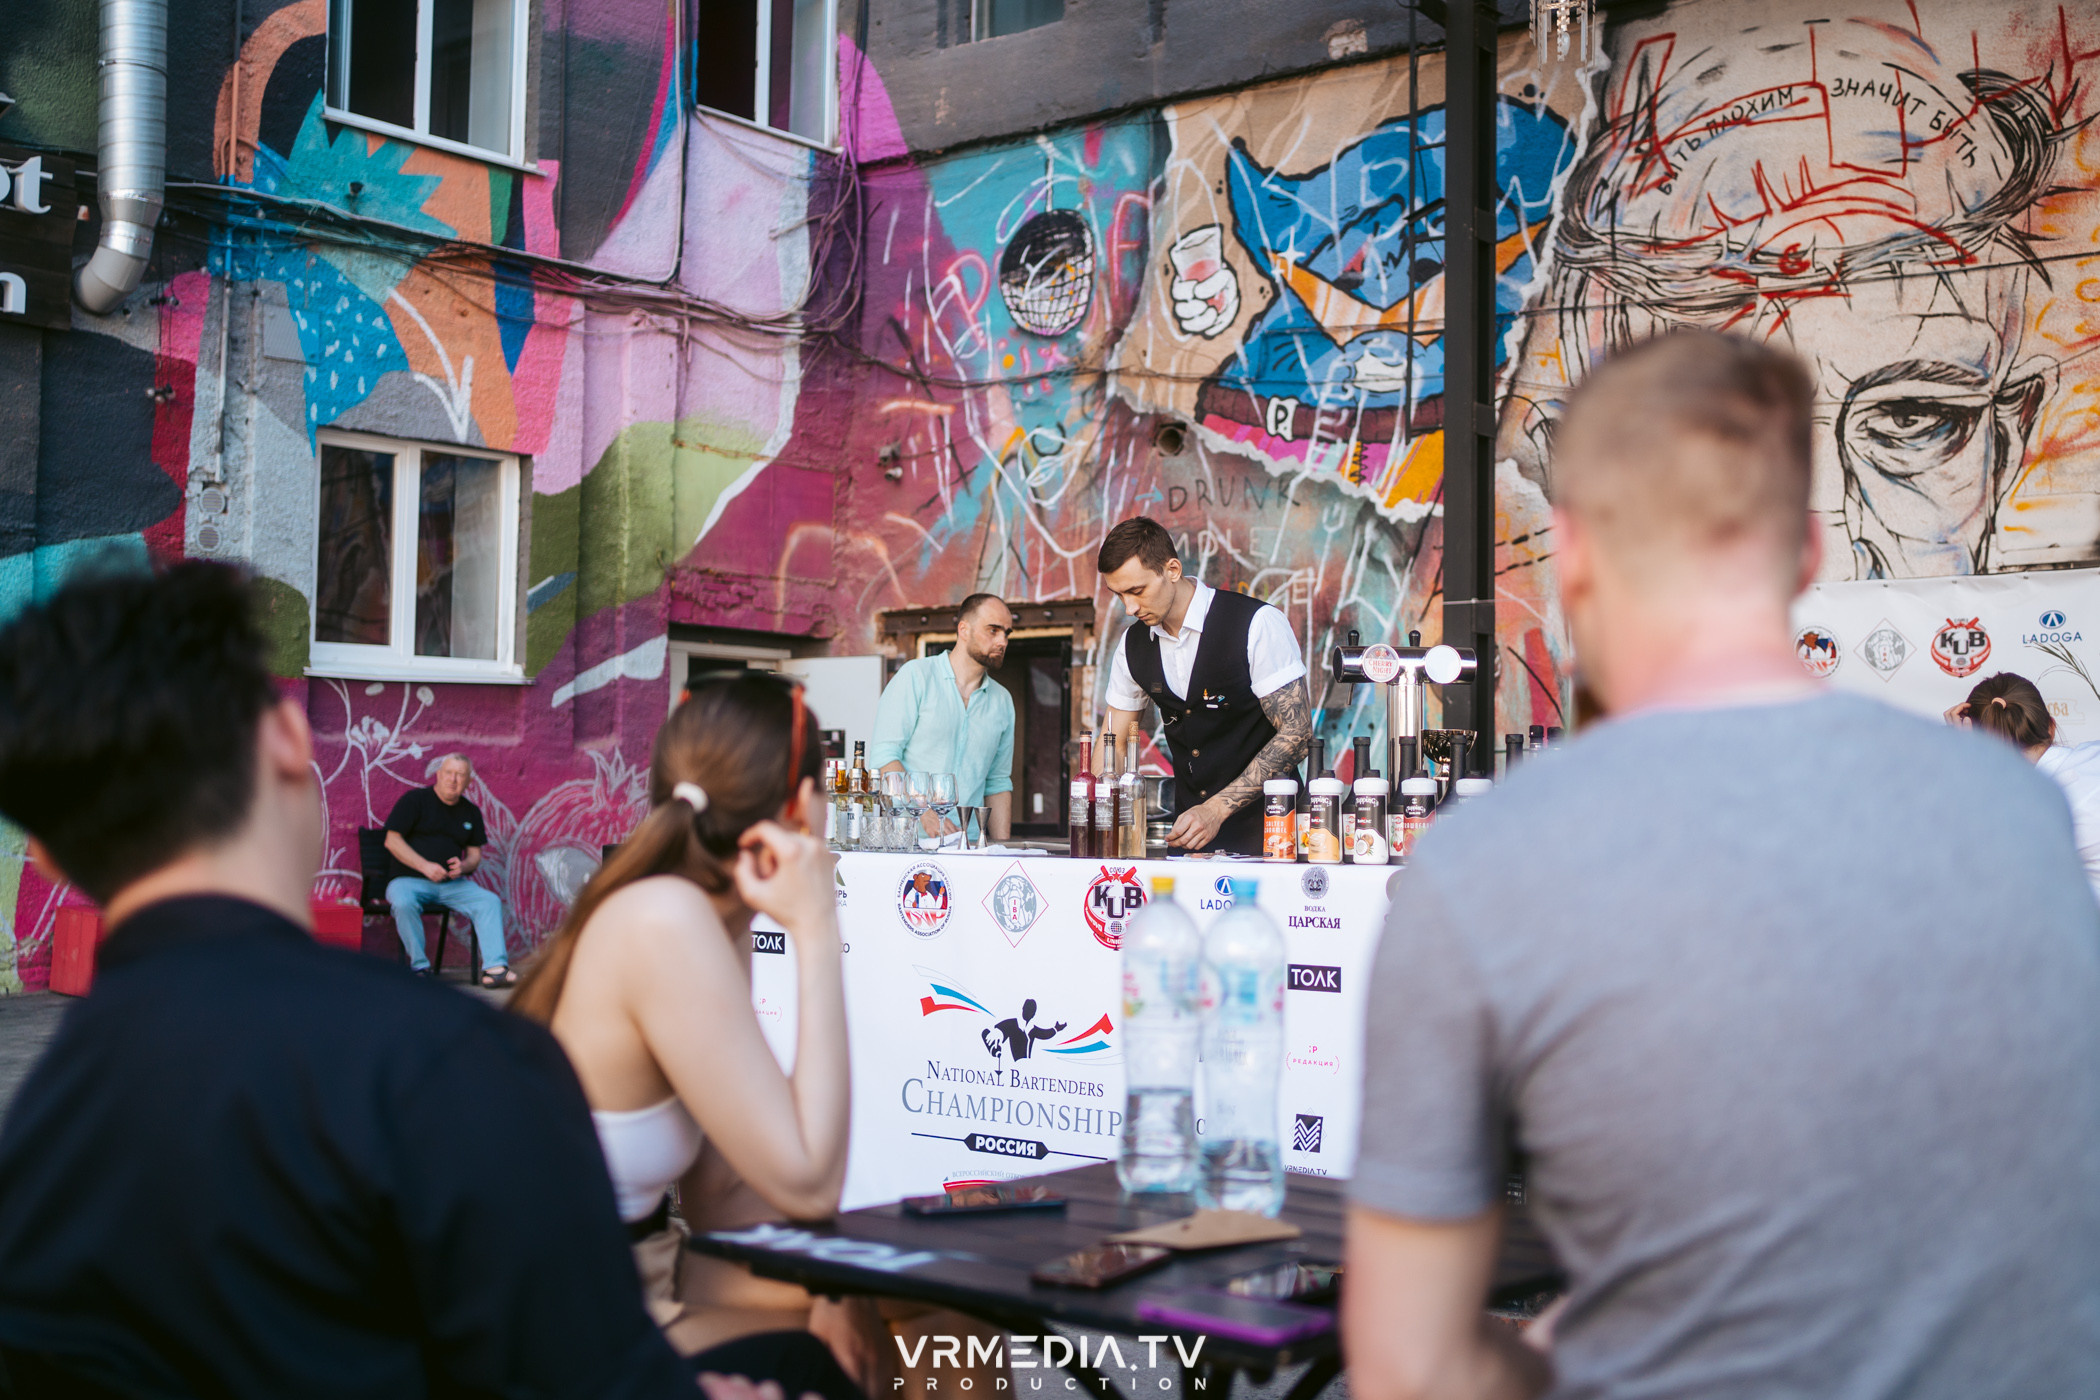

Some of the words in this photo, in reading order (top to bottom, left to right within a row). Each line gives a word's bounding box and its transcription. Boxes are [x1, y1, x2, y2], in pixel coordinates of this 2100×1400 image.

[1656, 137, 1700, 196] БЫТЬ
[1705, 87, 1793, 139] ПЛОХИМ
[1830, 78, 1927, 115] ЗНАЧИТ
[1929, 110, 1979, 168] БЫТЬ
[1168, 476, 1300, 513] DRUNK
[1940, 631, 1986, 655] KUB
[2022, 631, 2083, 644] LADOGA
[1093, 885, 1143, 919] KUB
[1200, 898, 1232, 910] LADO
[1304, 905, 1326, 913] ВОДКА
[1288, 915, 1341, 929] ЦАРСКАЯ
[1291, 968, 1338, 988] ТОЛК
[1292, 1058, 1334, 1067] РЕДАКЦИЯ
[1010, 1069, 1104, 1098] BARTENDERS
[975, 1136, 1037, 1157] РОССИЯ
